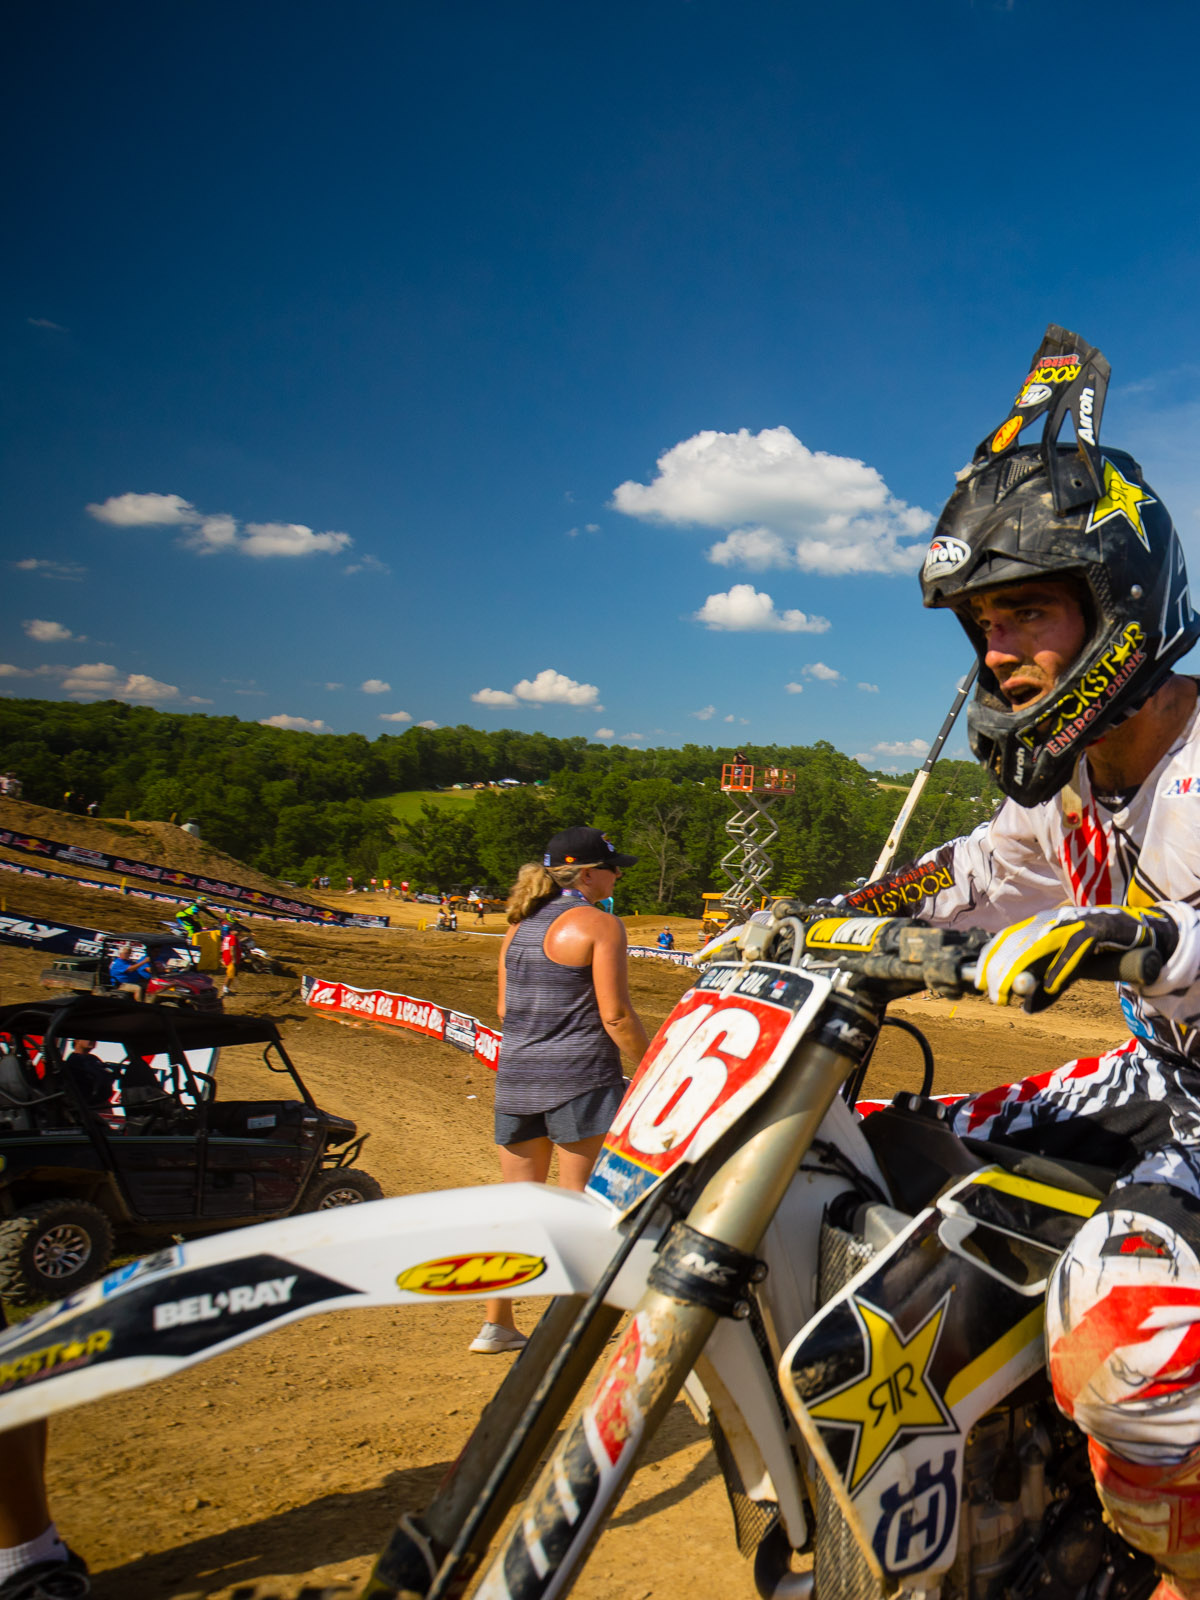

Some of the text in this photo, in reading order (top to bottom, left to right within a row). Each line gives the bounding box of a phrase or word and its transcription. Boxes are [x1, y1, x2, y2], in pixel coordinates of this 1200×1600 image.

[1046, 649, 1144, 755] ENERGY DRINK
[396, 1000, 430, 1027] LUCAS
[608, 1003, 760, 1155] 16
[400, 1255, 544, 1292] FMF
